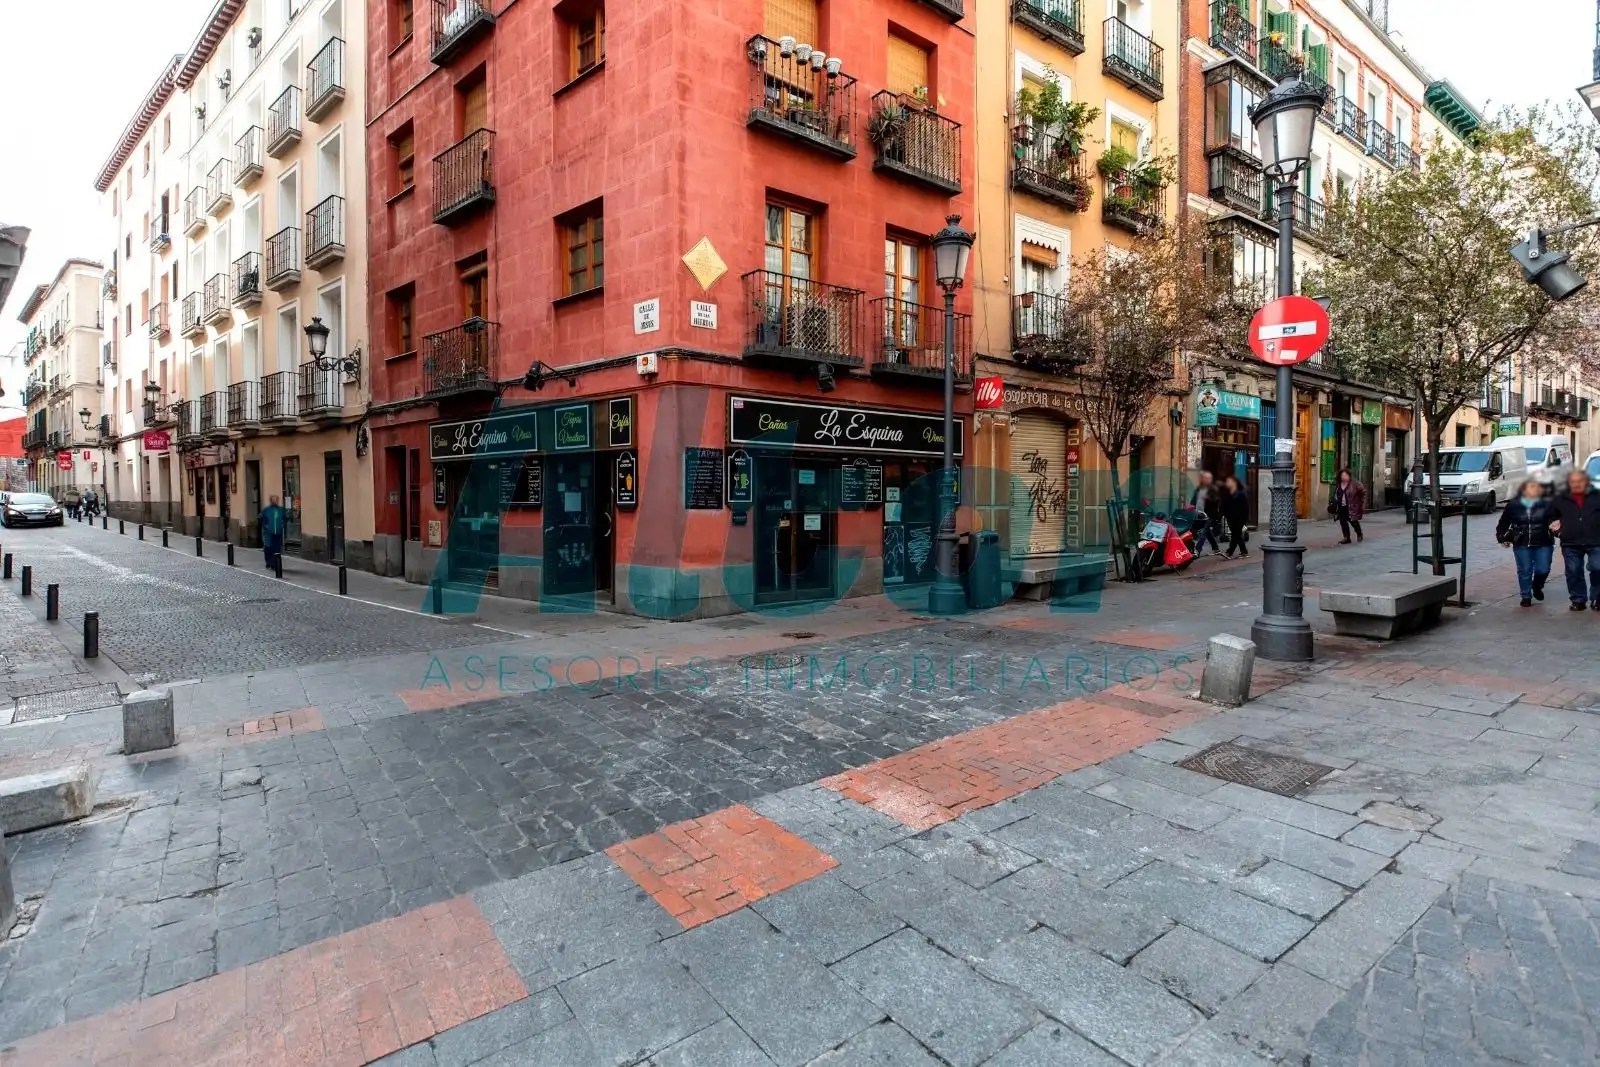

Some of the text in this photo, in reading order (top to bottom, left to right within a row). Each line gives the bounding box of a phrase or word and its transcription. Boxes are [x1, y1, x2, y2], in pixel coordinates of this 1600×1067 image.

[639, 303, 655, 313] CALLE
[696, 303, 711, 312] CALLE
[976, 381, 1001, 405] illy
[1001, 389, 1049, 408] OMPTOIR
[452, 423, 467, 455] La
[469, 422, 508, 452] Esquina
[758, 413, 788, 432] Cañas
[814, 409, 843, 446] La
[845, 413, 904, 447] Esquina
